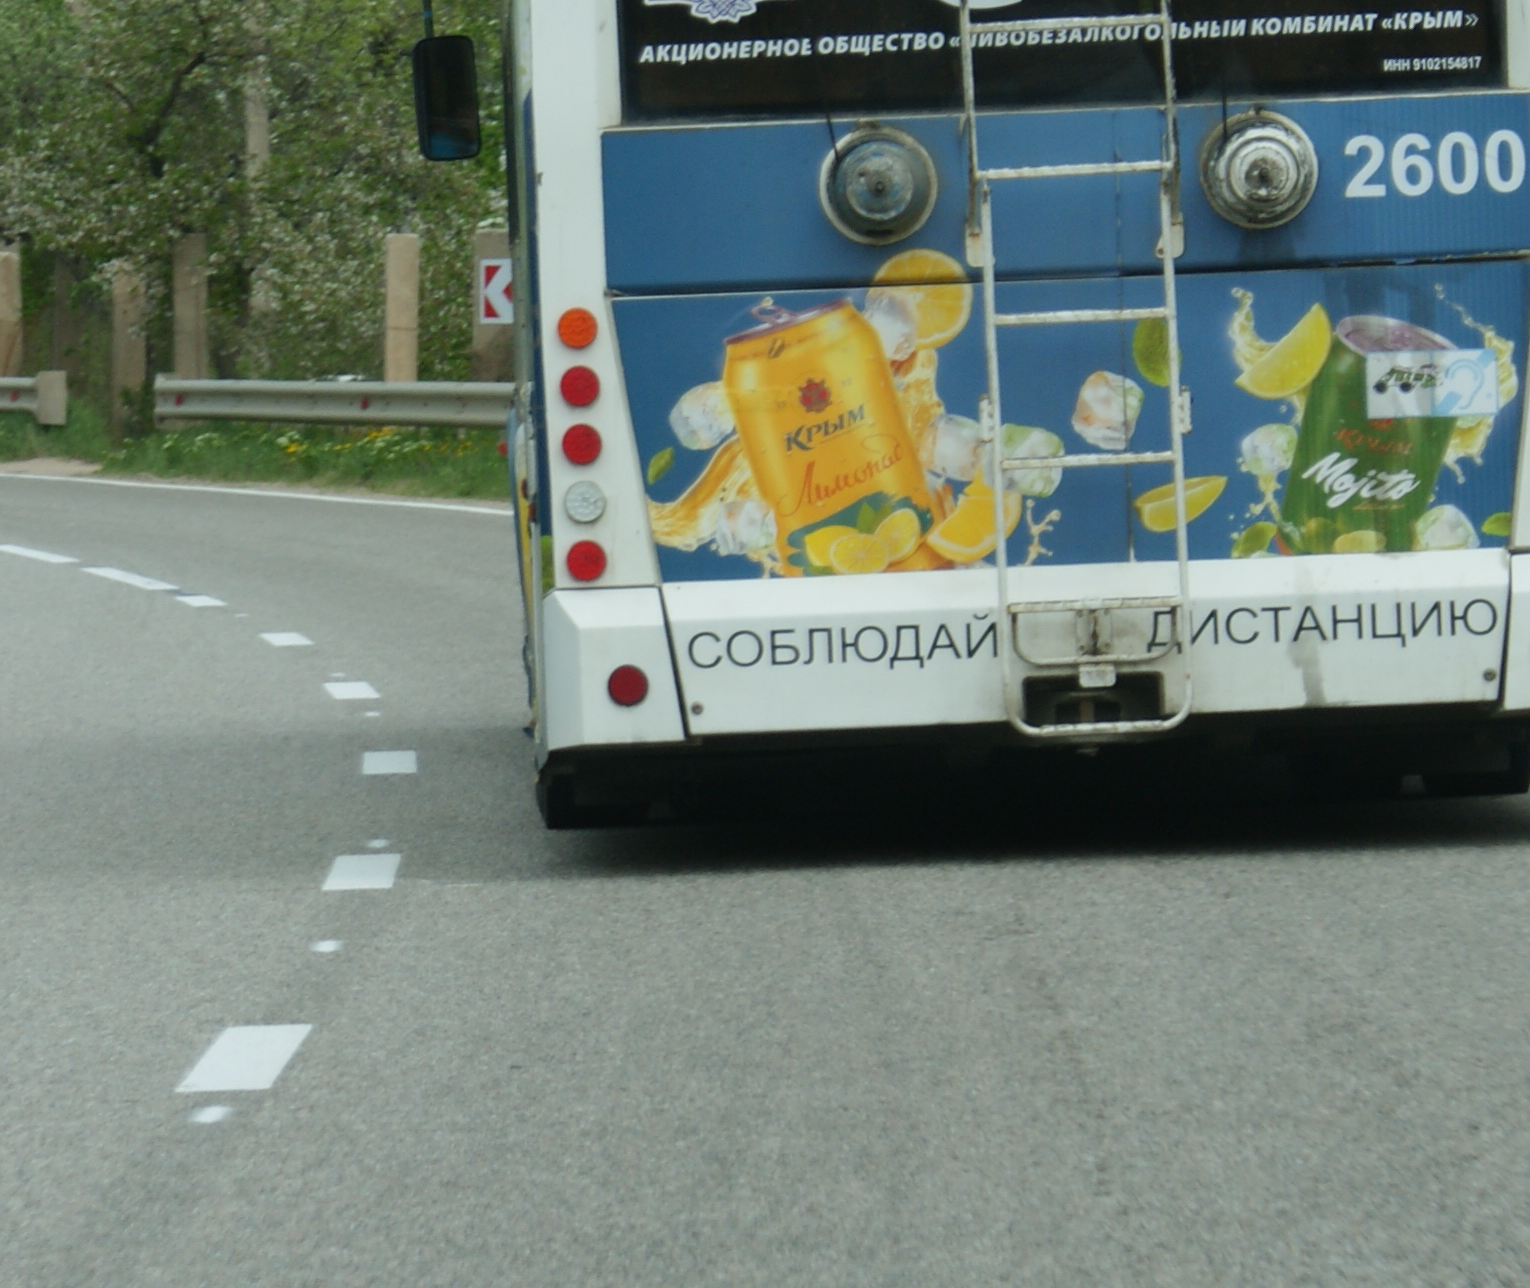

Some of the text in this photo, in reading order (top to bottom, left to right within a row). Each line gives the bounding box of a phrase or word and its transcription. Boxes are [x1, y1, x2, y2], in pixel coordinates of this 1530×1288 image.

[639, 38, 812, 64] АКЦИОНЕРНОЕ
[818, 31, 945, 56] ОБЩЕСТВО
[1250, 13, 1378, 36] КОМБИНАТ
[1381, 10, 1479, 30] «КРЫМ»
[1383, 58, 1410, 72] ИНН
[1343, 130, 1526, 199] 2600
[784, 404, 865, 452] КРЫМ
[1302, 451, 1421, 509] Mojito
[687, 598, 1498, 669] СОБЛЮДАЙ ДИСТАНЦИЮ
